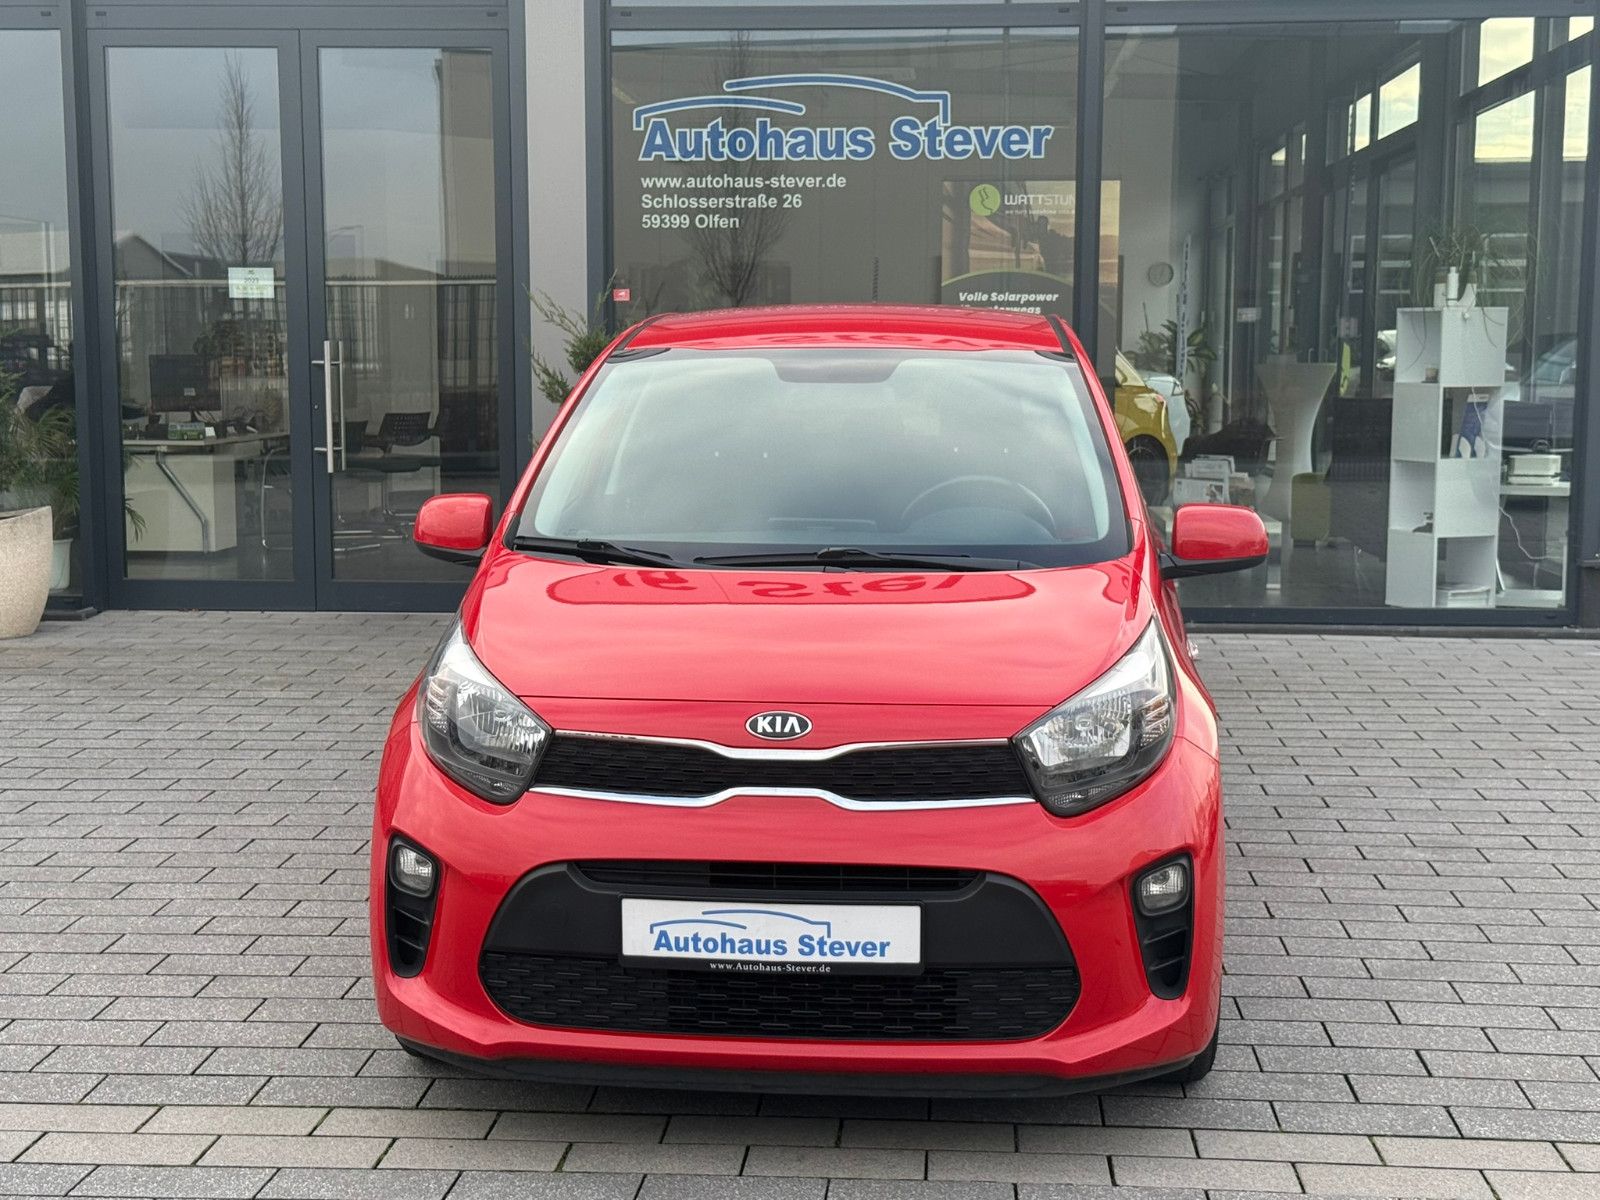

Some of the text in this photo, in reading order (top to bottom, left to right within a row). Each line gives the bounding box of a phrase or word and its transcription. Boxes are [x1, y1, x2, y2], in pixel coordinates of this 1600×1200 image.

[638, 117, 1054, 162] Autohaus Stever
[640, 173, 848, 190] www.autohaus-stever.de
[641, 193, 803, 209] Schlosserstraße 26
[641, 214, 740, 229] 59399 Olfen
[959, 291, 1059, 304] Volle Solarpower
[756, 716, 801, 733] KIA
[653, 929, 891, 958] Autohaus Stever
[709, 961, 831, 974] www.Autohaus-Stever.de
